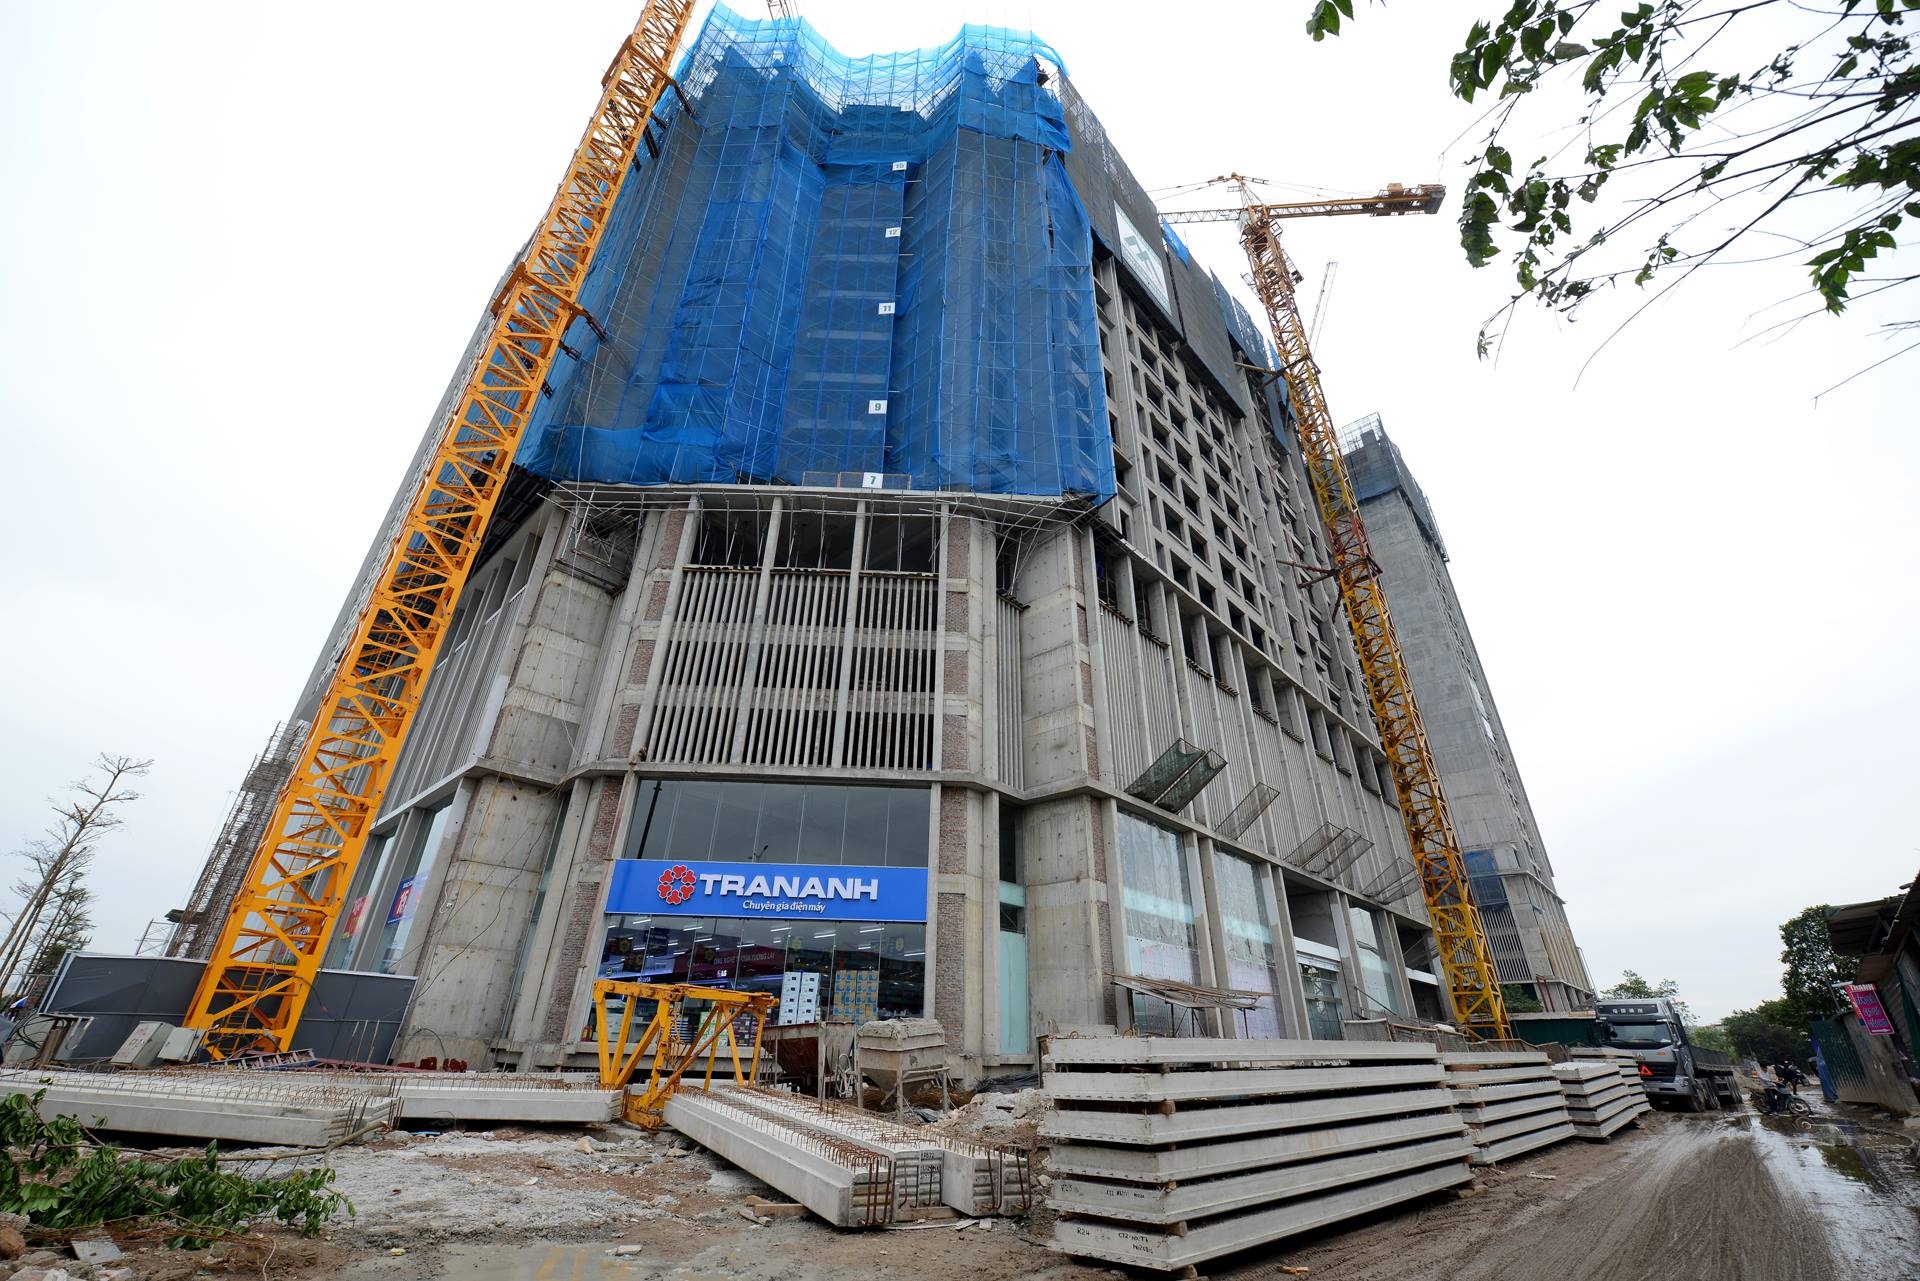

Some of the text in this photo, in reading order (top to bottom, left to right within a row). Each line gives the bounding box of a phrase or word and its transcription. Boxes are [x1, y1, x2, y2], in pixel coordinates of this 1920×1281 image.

[874, 402, 881, 411] 9
[870, 475, 876, 485] 7
[742, 900, 826, 914] Chuyên gia điện máy
